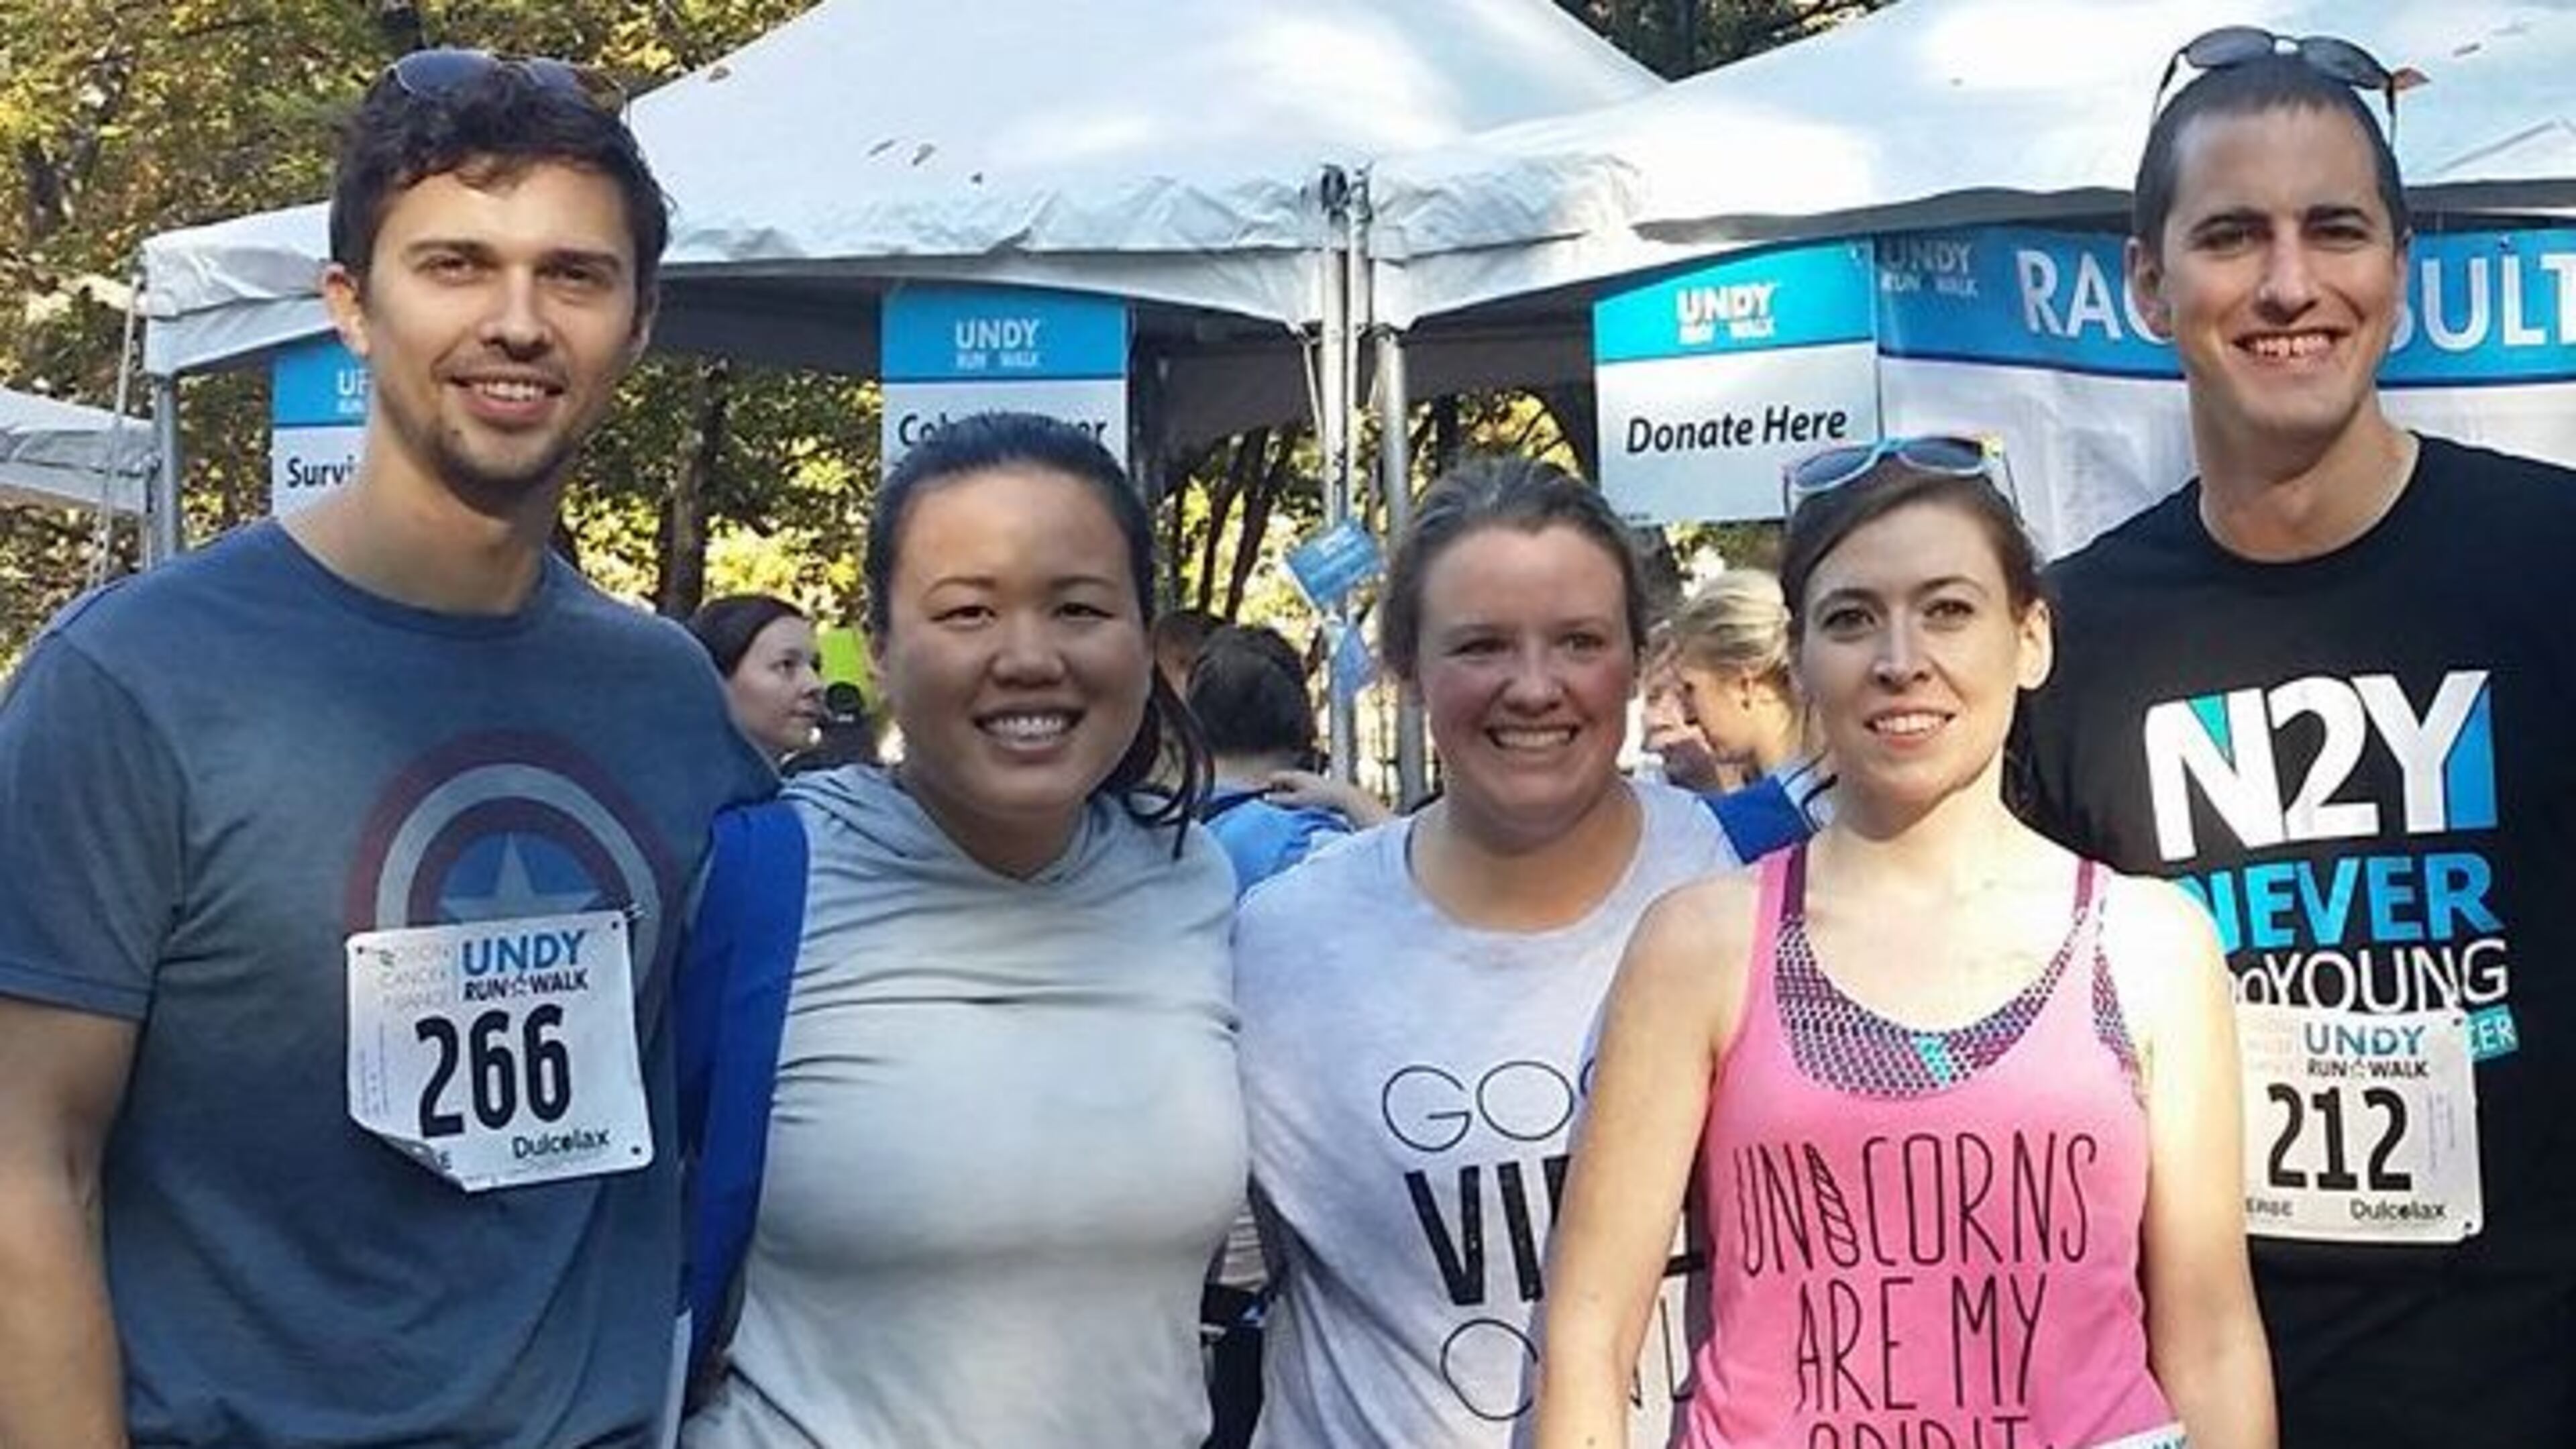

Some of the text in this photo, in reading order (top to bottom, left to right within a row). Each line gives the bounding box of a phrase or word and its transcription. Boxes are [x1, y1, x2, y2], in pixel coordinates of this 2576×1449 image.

[1882, 235, 1971, 274] UNDY
[1677, 282, 1778, 324] UNDY
[956, 318, 1040, 349] UNDY
[1627, 405, 1846, 454] Donate Here
[2145, 671, 2491, 862] N2Y
[462, 930, 584, 975] UNDY
[2304, 1022, 2425, 1056] UNDY
[415, 1004, 571, 1138] 266
[1382, 1061, 1595, 1152] GO
[2267, 1083, 2412, 1191] 212
[1796, 1273, 2047, 1414] ARE MY
